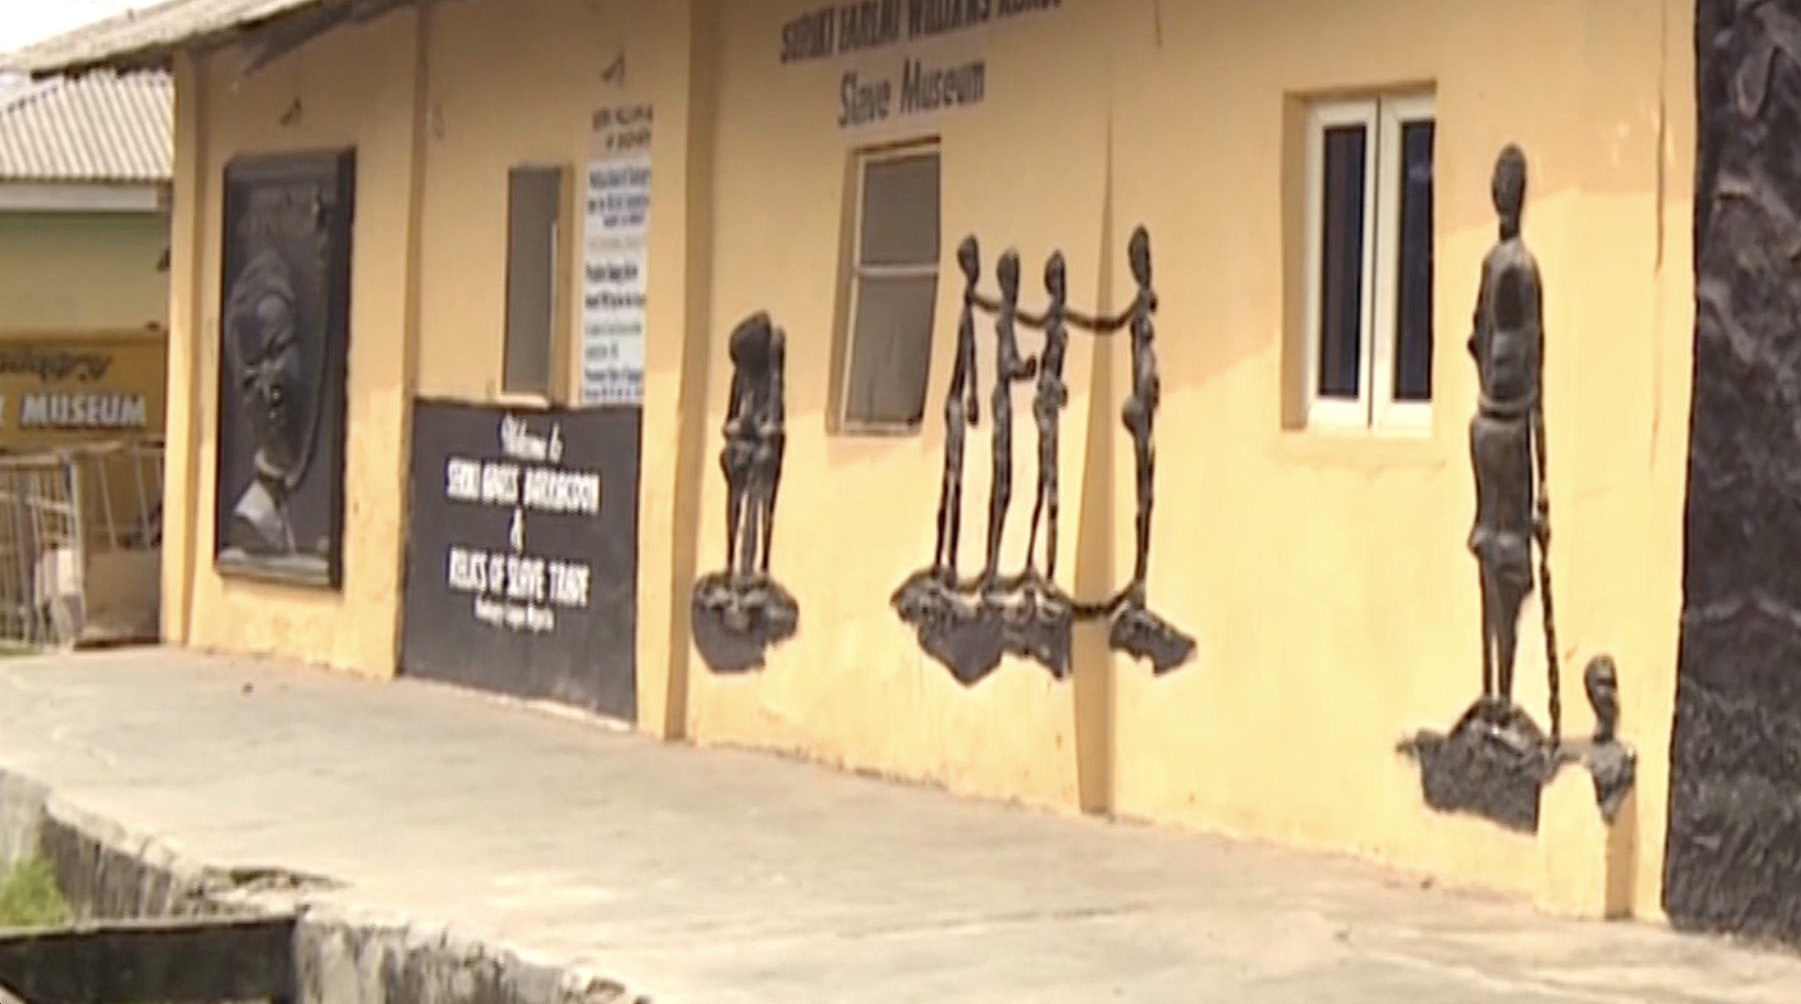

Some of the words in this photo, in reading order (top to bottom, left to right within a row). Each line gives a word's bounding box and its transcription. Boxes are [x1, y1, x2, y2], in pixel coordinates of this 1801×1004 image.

[838, 70, 891, 128] Slave
[900, 58, 986, 114] Museum
[20, 392, 147, 428] MUSEUM
